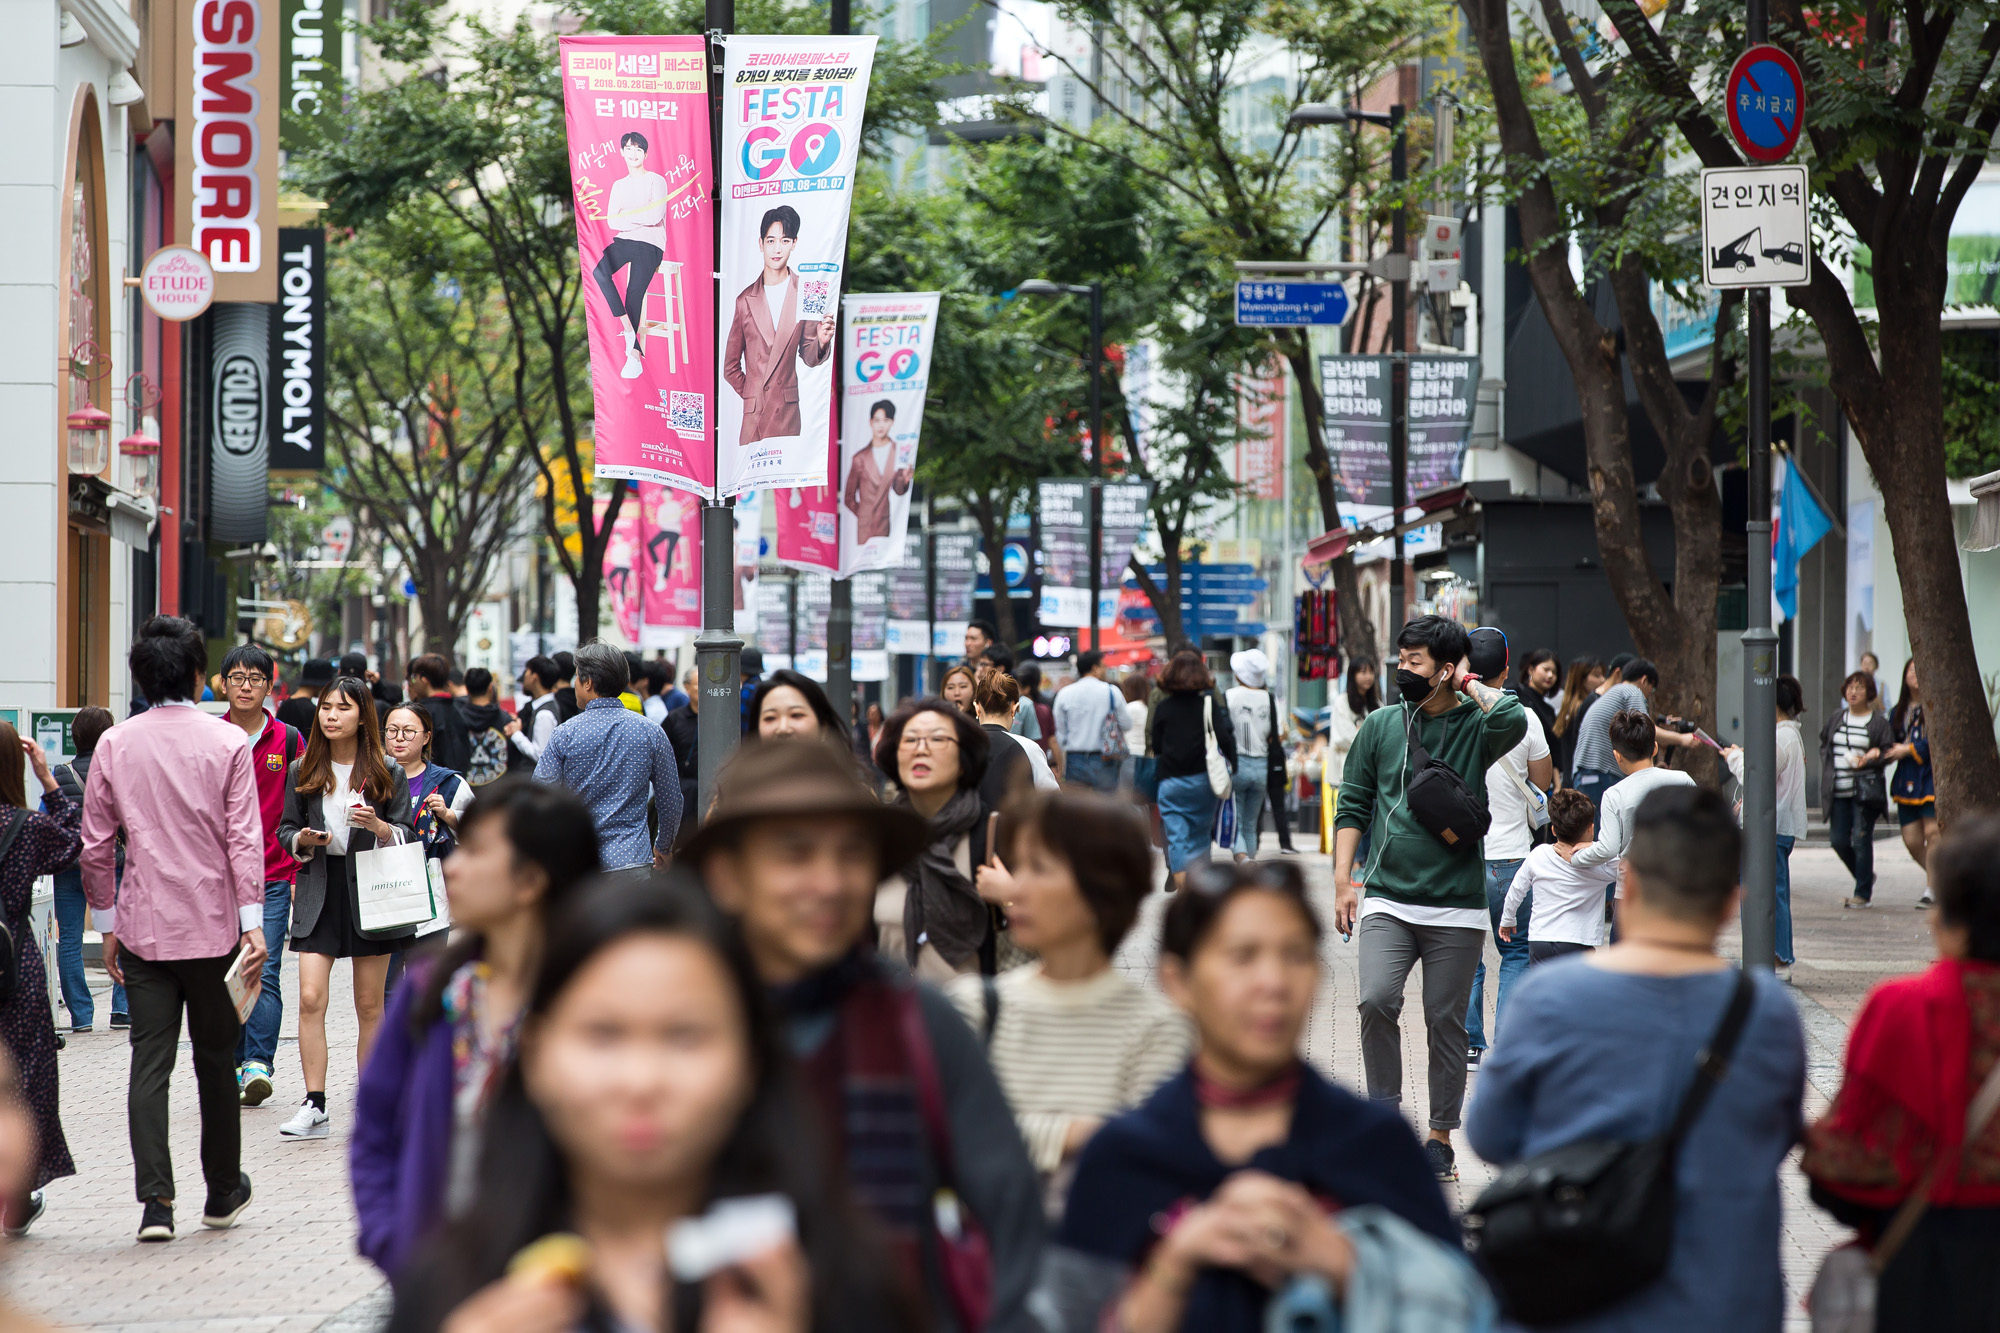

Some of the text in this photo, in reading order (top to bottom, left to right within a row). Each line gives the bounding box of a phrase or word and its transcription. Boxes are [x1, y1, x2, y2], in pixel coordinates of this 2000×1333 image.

[572, 55, 704, 74] 코리아 세일 페스타
[746, 52, 850, 66] 코리아세일페스타
[736, 67, 857, 83] 8개의 뱃지를 찾아라!
[595, 98, 679, 120] 단 10일간
[743, 86, 843, 122] FESTA
[1740, 94, 1794, 115] 주차금지
[741, 123, 841, 181] GO
[733, 182, 780, 199] 이벤트기간
[1711, 182, 1800, 209] 견인지역
[149, 275, 209, 291] ETUDE
[1240, 284, 1286, 301] 명동4길
[157, 293, 200, 304] HOUSE
[1240, 302, 1301, 314] Myeongdong
[856, 325, 920, 347] FESTA
[282, 244, 313, 452] TONYMOLY
[856, 349, 919, 383] GO
[222, 359, 258, 452] FOLDER
[371, 878, 413, 891] innisfree
